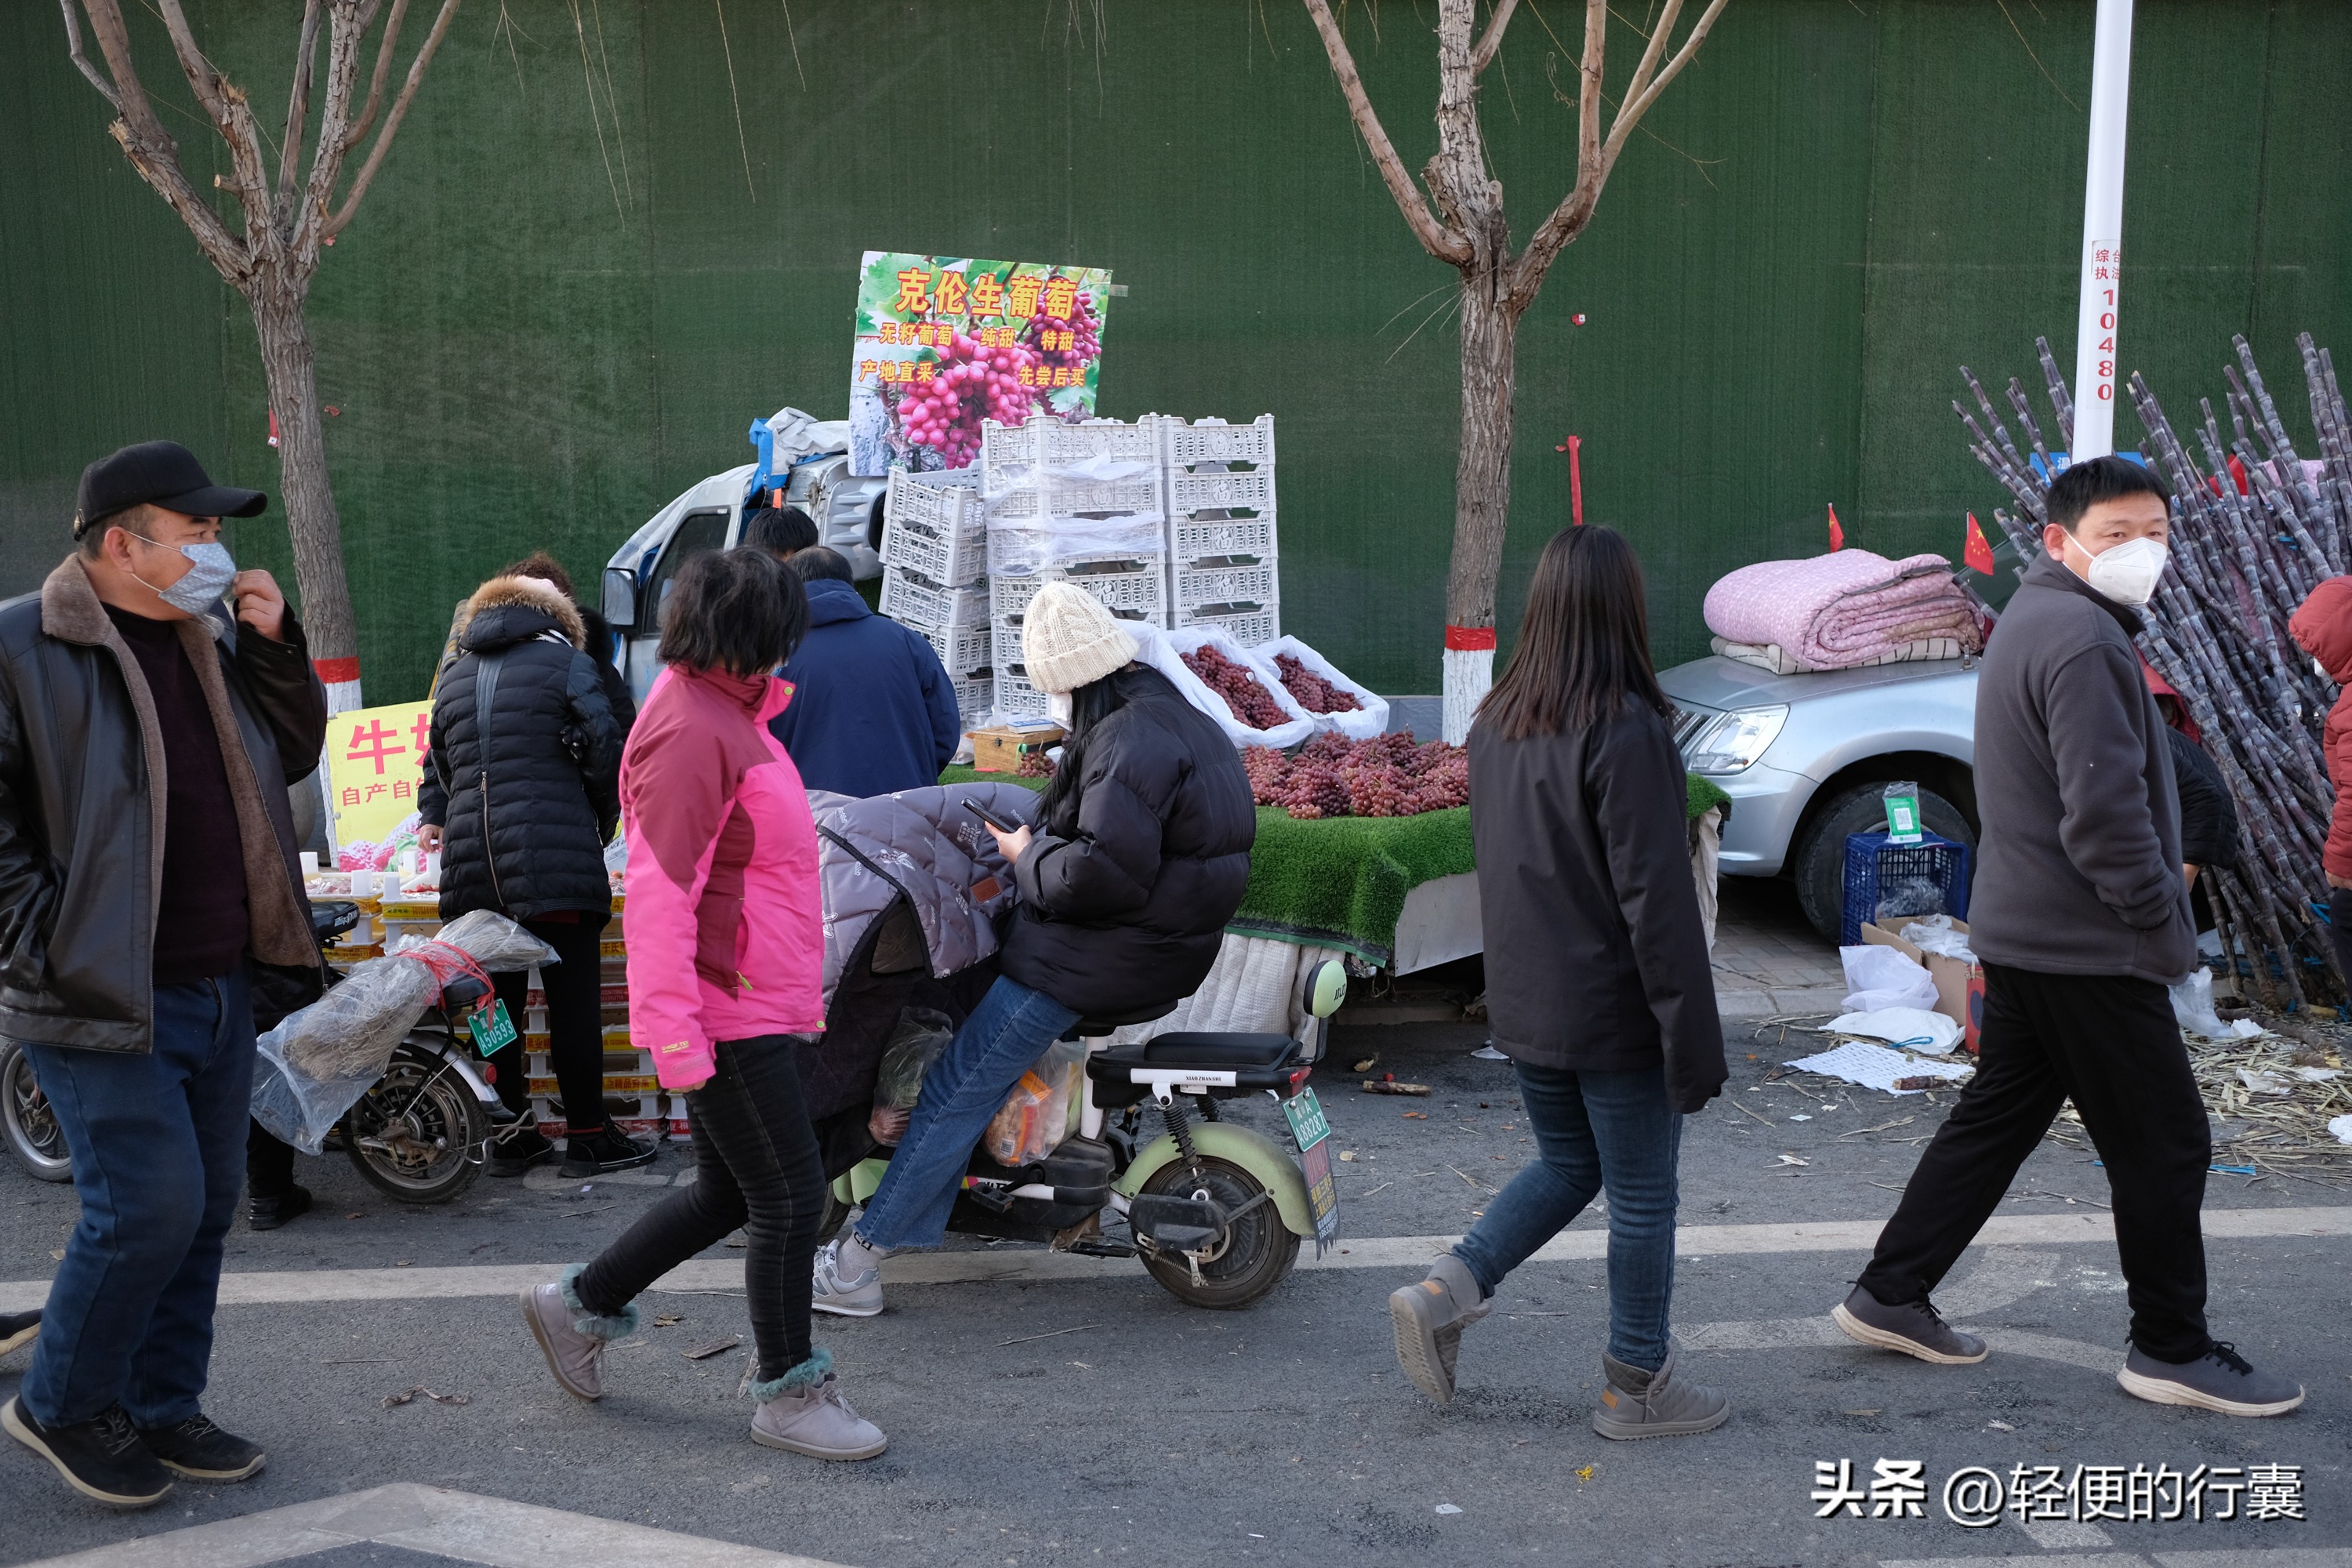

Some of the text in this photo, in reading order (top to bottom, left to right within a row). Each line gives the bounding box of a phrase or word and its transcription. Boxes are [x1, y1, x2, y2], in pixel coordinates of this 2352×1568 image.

[2095, 249, 2120, 263] 综合
[896, 267, 1079, 321] 克伦生葡萄
[880, 322, 1075, 351] 无籽葡萄 纯甜 特甜
[2097, 289, 2115, 400] 10480
[859, 360, 1086, 387] 产地直采 先尝后买
[479, 1020, 514, 1051] A50593
[1295, 1111, 1326, 1144] A88287
